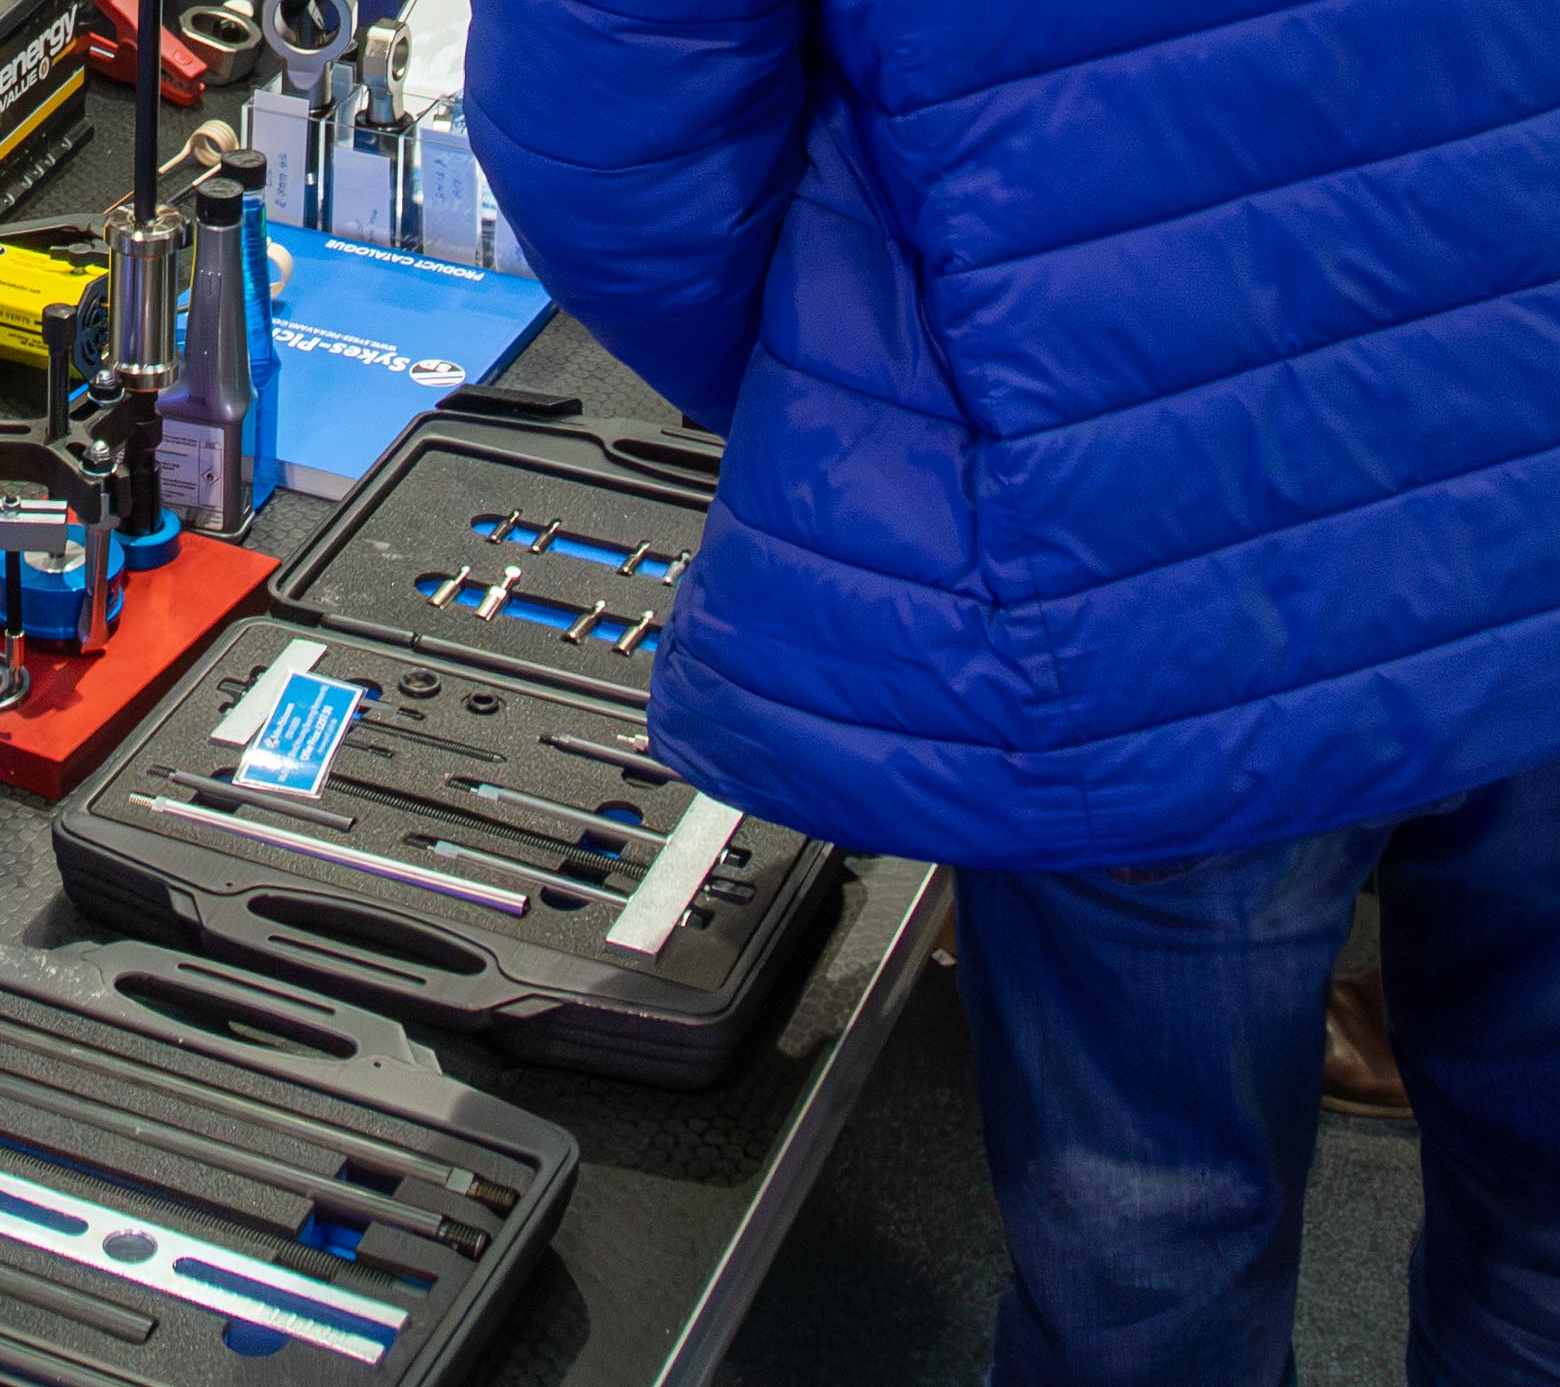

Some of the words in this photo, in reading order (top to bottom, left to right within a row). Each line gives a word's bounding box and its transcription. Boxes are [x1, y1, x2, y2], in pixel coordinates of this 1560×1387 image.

[325, 239, 417, 266] CATALOGUE
[413, 257, 486, 282] PRODUCT
[6, 309, 31, 325] VENTS
